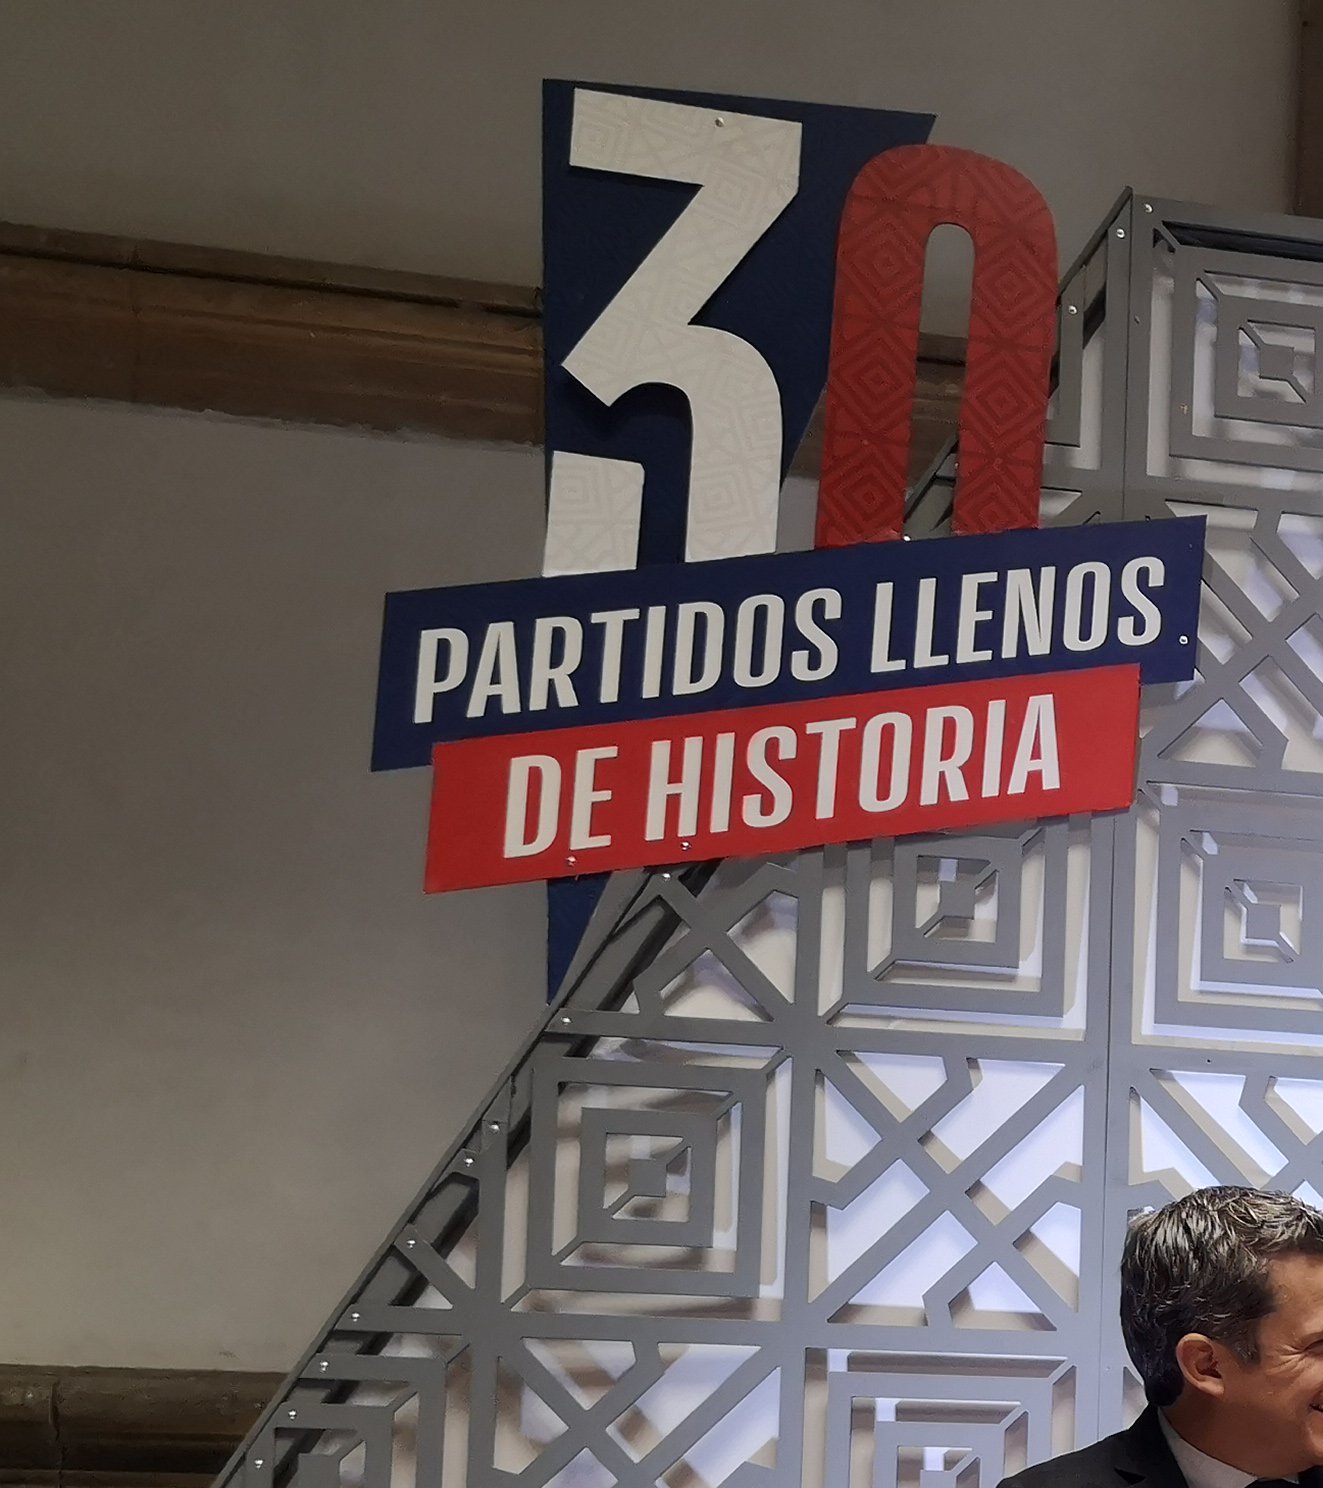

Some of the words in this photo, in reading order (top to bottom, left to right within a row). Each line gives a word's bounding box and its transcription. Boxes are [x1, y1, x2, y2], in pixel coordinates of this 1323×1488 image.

[543, 88, 1059, 577] 30
[413, 588, 842, 724] PARTIDOS
[870, 556, 1166, 673] LLENOS
[503, 745, 620, 859] DE
[643, 694, 1061, 842] HISTORIA
